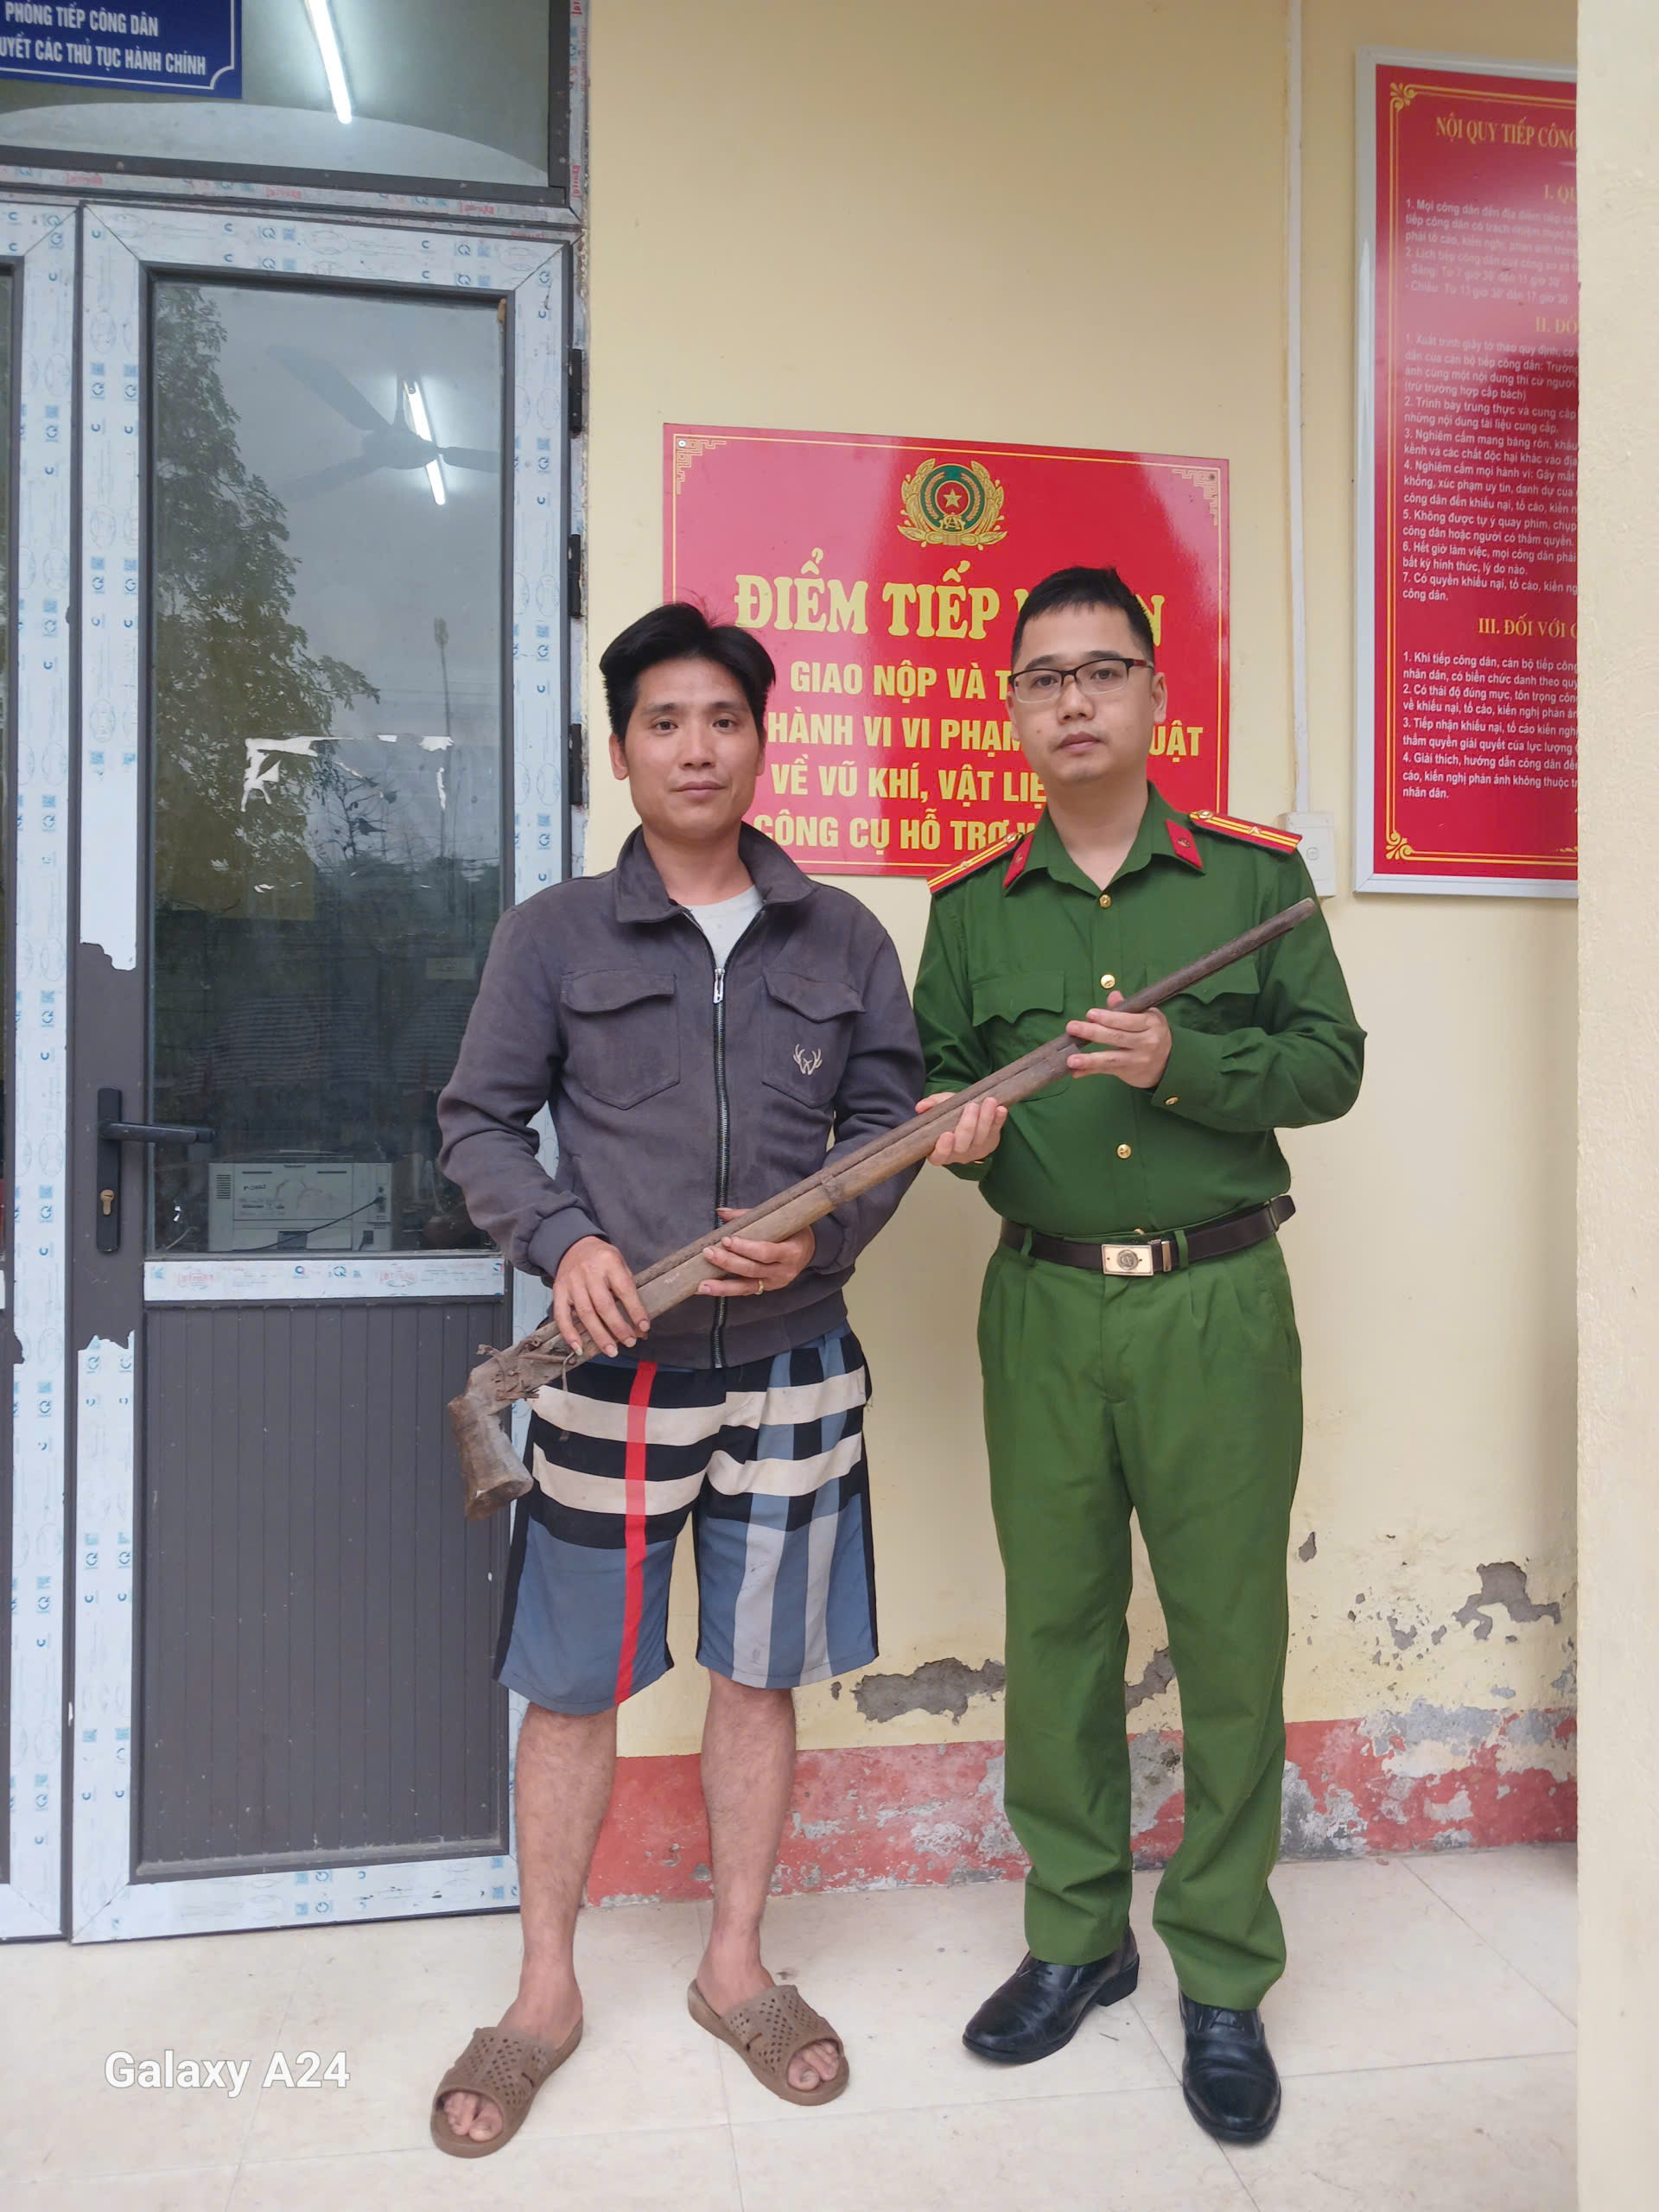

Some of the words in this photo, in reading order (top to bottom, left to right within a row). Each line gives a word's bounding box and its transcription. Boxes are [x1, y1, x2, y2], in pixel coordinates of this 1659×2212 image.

[55, 2, 86, 29] TIẾP
[90, 8, 126, 34] CÔNG
[131, 11, 158, 37] DÂN
[0, 31, 31, 59] UYẾT
[35, 37, 63, 62] CÁC
[66, 37, 92, 65] THỦ
[95, 46, 121, 72] TỤC
[124, 46, 162, 72] HÀNH
[165, 50, 206, 76] CHÍNH
[1436, 111, 1462, 143] NỘI
[1466, 119, 1497, 144] QUY
[1501, 116, 1535, 146] TIẾP
[734, 547, 868, 634] ĐIỂM
[882, 560, 1000, 639] TIẾP
[1478, 618, 1500, 634] III.
[1503, 612, 1531, 636] ĐỐI
[1537, 616, 1566, 638] VỚI
[1403, 652, 1411, 661] 1.
[1414, 652, 1430, 662] Khi
[1433, 651, 1450, 666] tiếp
[1452, 654, 1476, 667] công
[1478, 656, 1499, 668] dân,
[1502, 657, 1518, 667] cán
[1522, 658, 1533, 671] bộ
[1536, 656, 1553, 672] tiếp
[1556, 660, 1576, 673] công
[791, 660, 862, 695] GIAO
[873, 659, 937, 703] NỘP
[947, 663, 986, 699] VÀ
[1402, 683, 1411, 694] 2.
[1414, 684, 1427, 695] Có
[1429, 685, 1446, 696] thái
[1448, 686, 1460, 698] độ
[1463, 687, 1486, 700] đúng
[1489, 690, 1511, 701] mực,
[1515, 690, 1529, 700] tôn
[1532, 691, 1555, 704] trọng
[1403, 668, 1426, 678] nhân
[1428, 670, 1448, 681] dân,
[1451, 671, 1462, 680] có
[1465, 669, 1484, 682] biển
[1487, 672, 1510, 683] chức
[1513, 674, 1536, 684] danh
[1539, 676, 1559, 685] theo
[1561, 679, 1577, 690] quy
[767, 706, 853, 746] HÀNH
[864, 716, 892, 747] VI
[902, 717, 930, 748] VI
[941, 719, 1021, 757] PHẠM
[1149, 720, 1203, 763] UẬT
[1402, 732, 1426, 745] thẩm
[1428, 734, 1457, 749] quyền
[1459, 738, 1477, 750] giải
[1479, 736, 1504, 752] quyết
[1507, 740, 1523, 750] của
[1527, 741, 1541, 753] lực
[1544, 742, 1572, 755] lượng
[1402, 752, 1411, 761] 4.
[1414, 753, 1432, 762] Giải
[1434, 753, 1461, 766] thích,
[1464, 755, 1495, 768] hướng
[1497, 753, 1515, 766] dẫn
[1517, 758, 1541, 771] công
[1543, 759, 1560, 769] dân
[771, 753, 808, 795] VỀ
[818, 760, 857, 797] VŨ
[868, 762, 928, 804] KHÍ,
[938, 764, 994, 807] VẬT
[1003, 771, 1046, 809] LIỆ
[1402, 770, 1421, 782] cáo,
[1424, 768, 1443, 781] kiến
[1446, 772, 1465, 785] nghị
[1468, 773, 1491, 786] phản
[1493, 774, 1510, 785] ánh
[1513, 775, 1541, 788] không
[1543, 777, 1568, 789] thuộc
[1402, 786, 1426, 797] nhân
[1428, 787, 1449, 798] dân.
[753, 809, 838, 847] CÔNG
[849, 818, 890, 855] CỤ
[900, 809, 940, 849] HỖ
